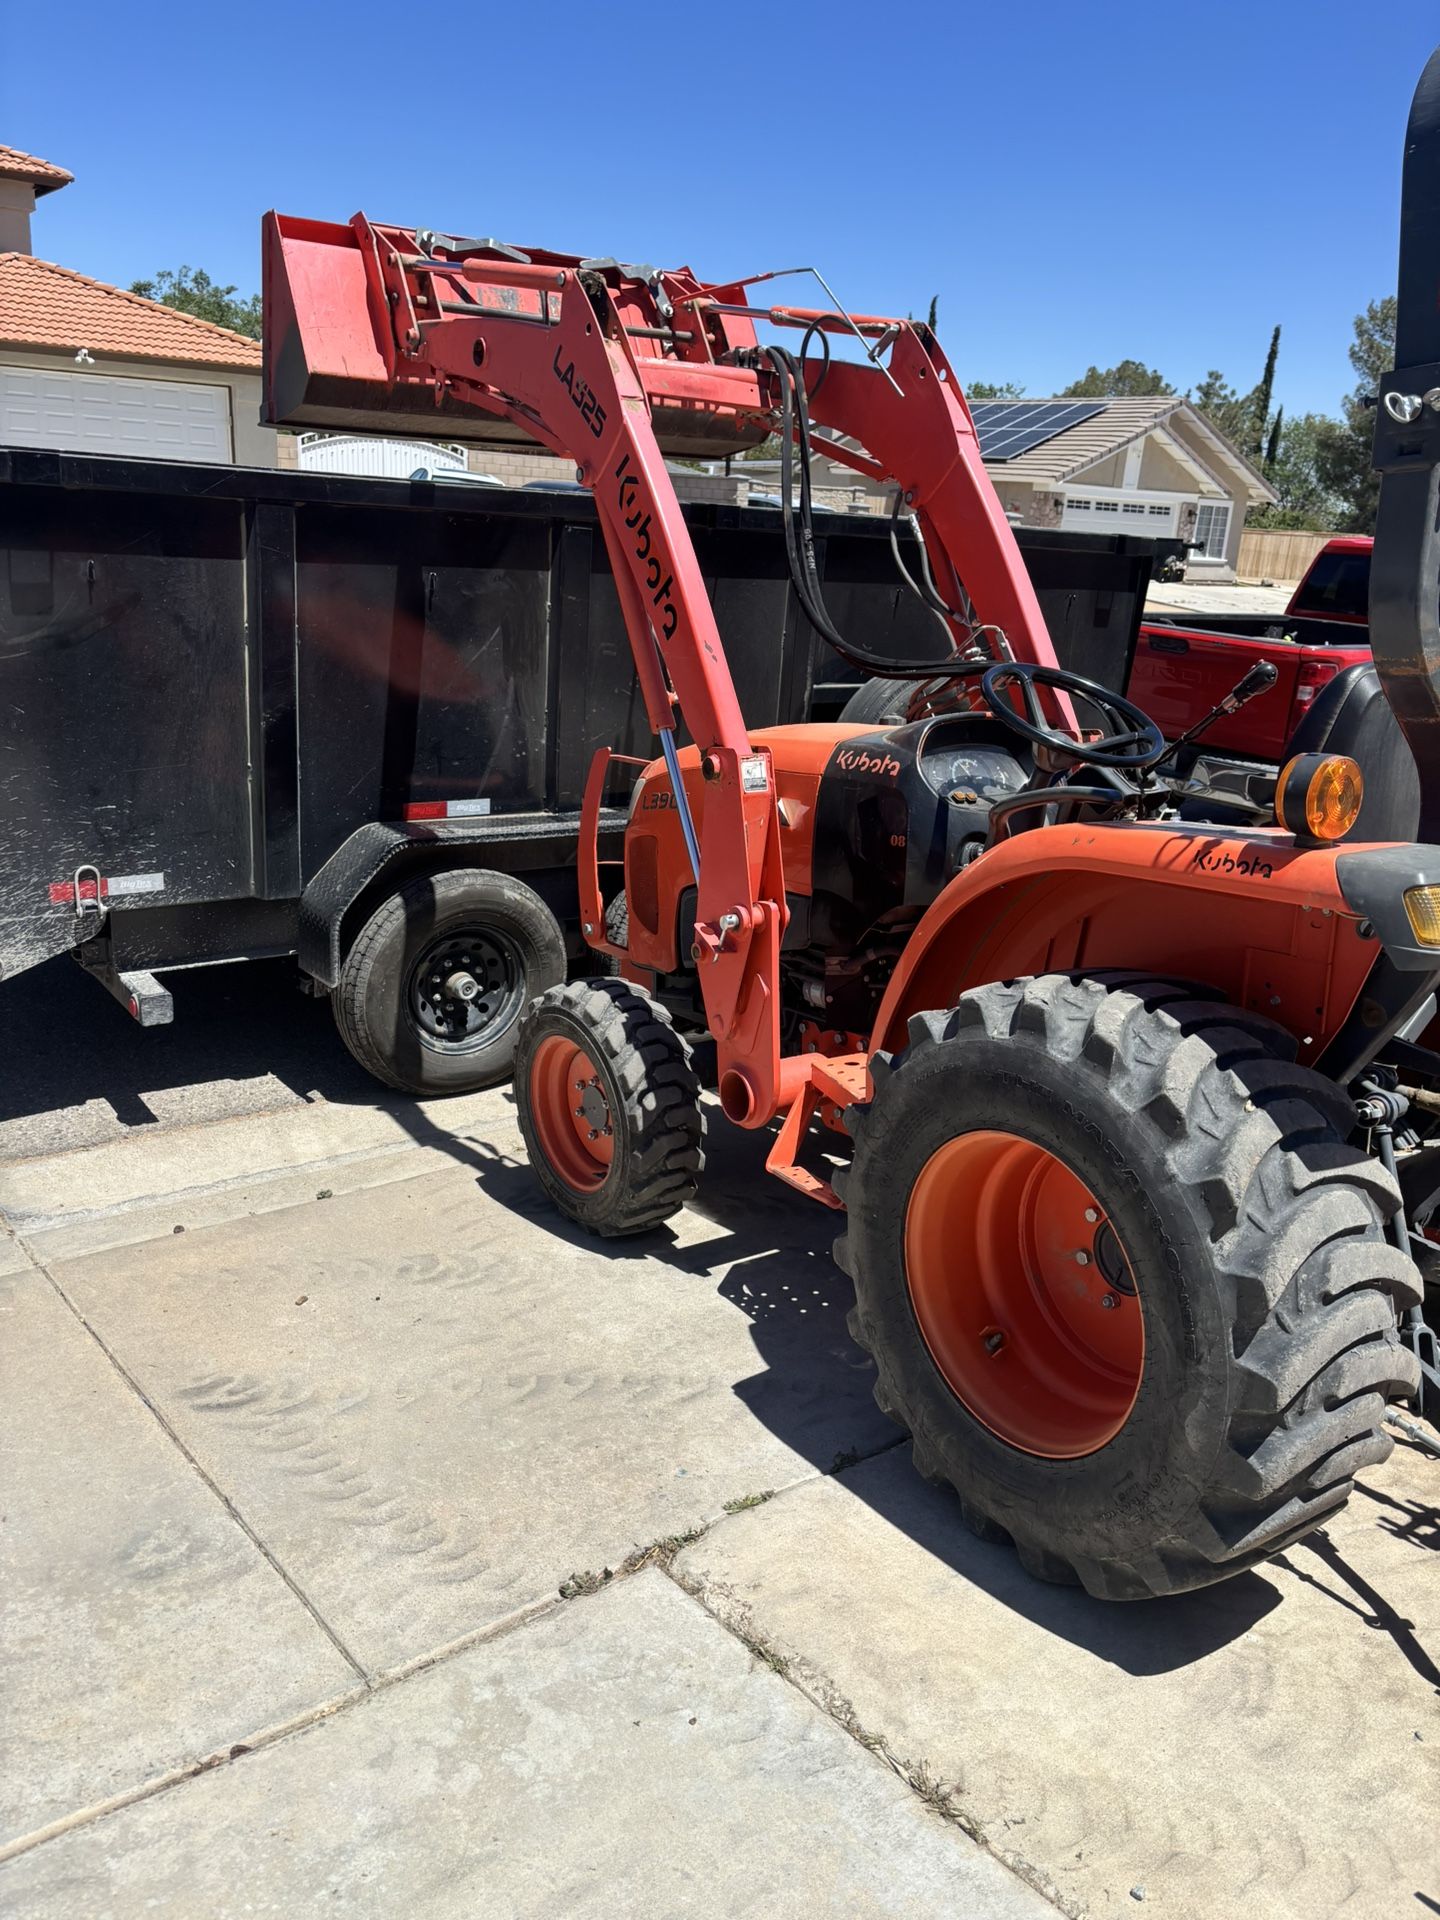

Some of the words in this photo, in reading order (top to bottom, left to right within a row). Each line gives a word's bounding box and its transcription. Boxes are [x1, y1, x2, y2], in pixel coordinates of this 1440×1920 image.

[615, 454, 679, 641] Kubota
[836, 750, 901, 776] Kubota
[642, 791, 690, 810] L390
[890, 834, 906, 847] 08
[1193, 849, 1273, 878] Kubota
